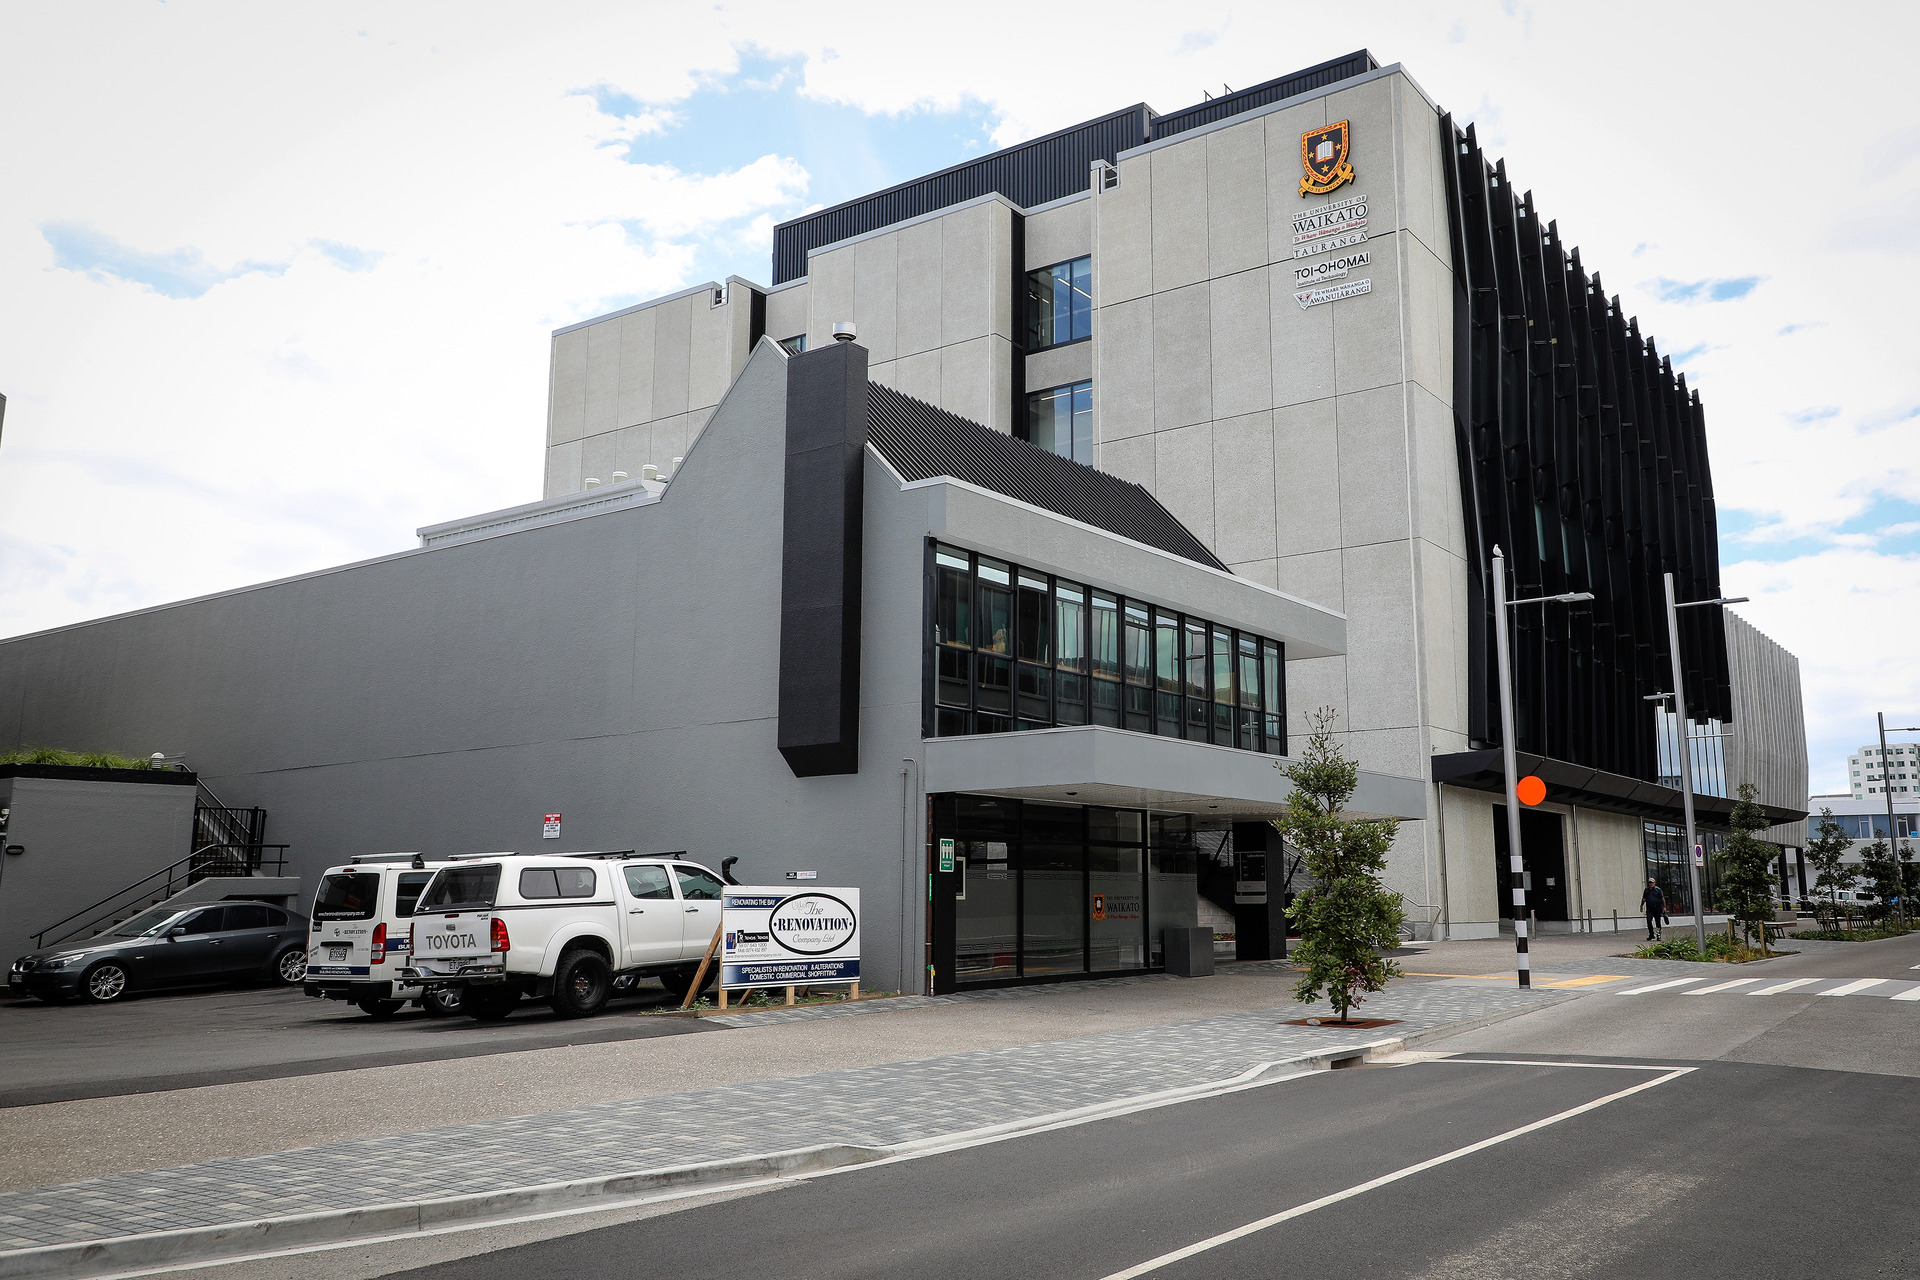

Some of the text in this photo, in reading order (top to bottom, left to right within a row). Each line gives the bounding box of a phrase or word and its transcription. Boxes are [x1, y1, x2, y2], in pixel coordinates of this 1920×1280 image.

[1310, 199, 1353, 215] UNIVERSITY
[1293, 204, 1367, 234] WAIKATO
[1294, 233, 1366, 258] TAURANGA
[1294, 252, 1369, 279] TOI-OHOMAI
[1321, 271, 1347, 281] Technology
[1321, 287, 1339, 295] WHARE
[804, 902, 823, 915] The
[1107, 902, 1139, 912] WAIKATO
[777, 918, 849, 931] RENOVATION
[426, 933, 476, 949] TOYOTA
[792, 934, 836, 946] Company Ltd
[741, 966, 772, 974] SPECIALISTS
[779, 964, 808, 972] RENOVATION
[815, 962, 844, 970] ALTERATIONS
[776, 971, 806, 979] COMMERCIAL
